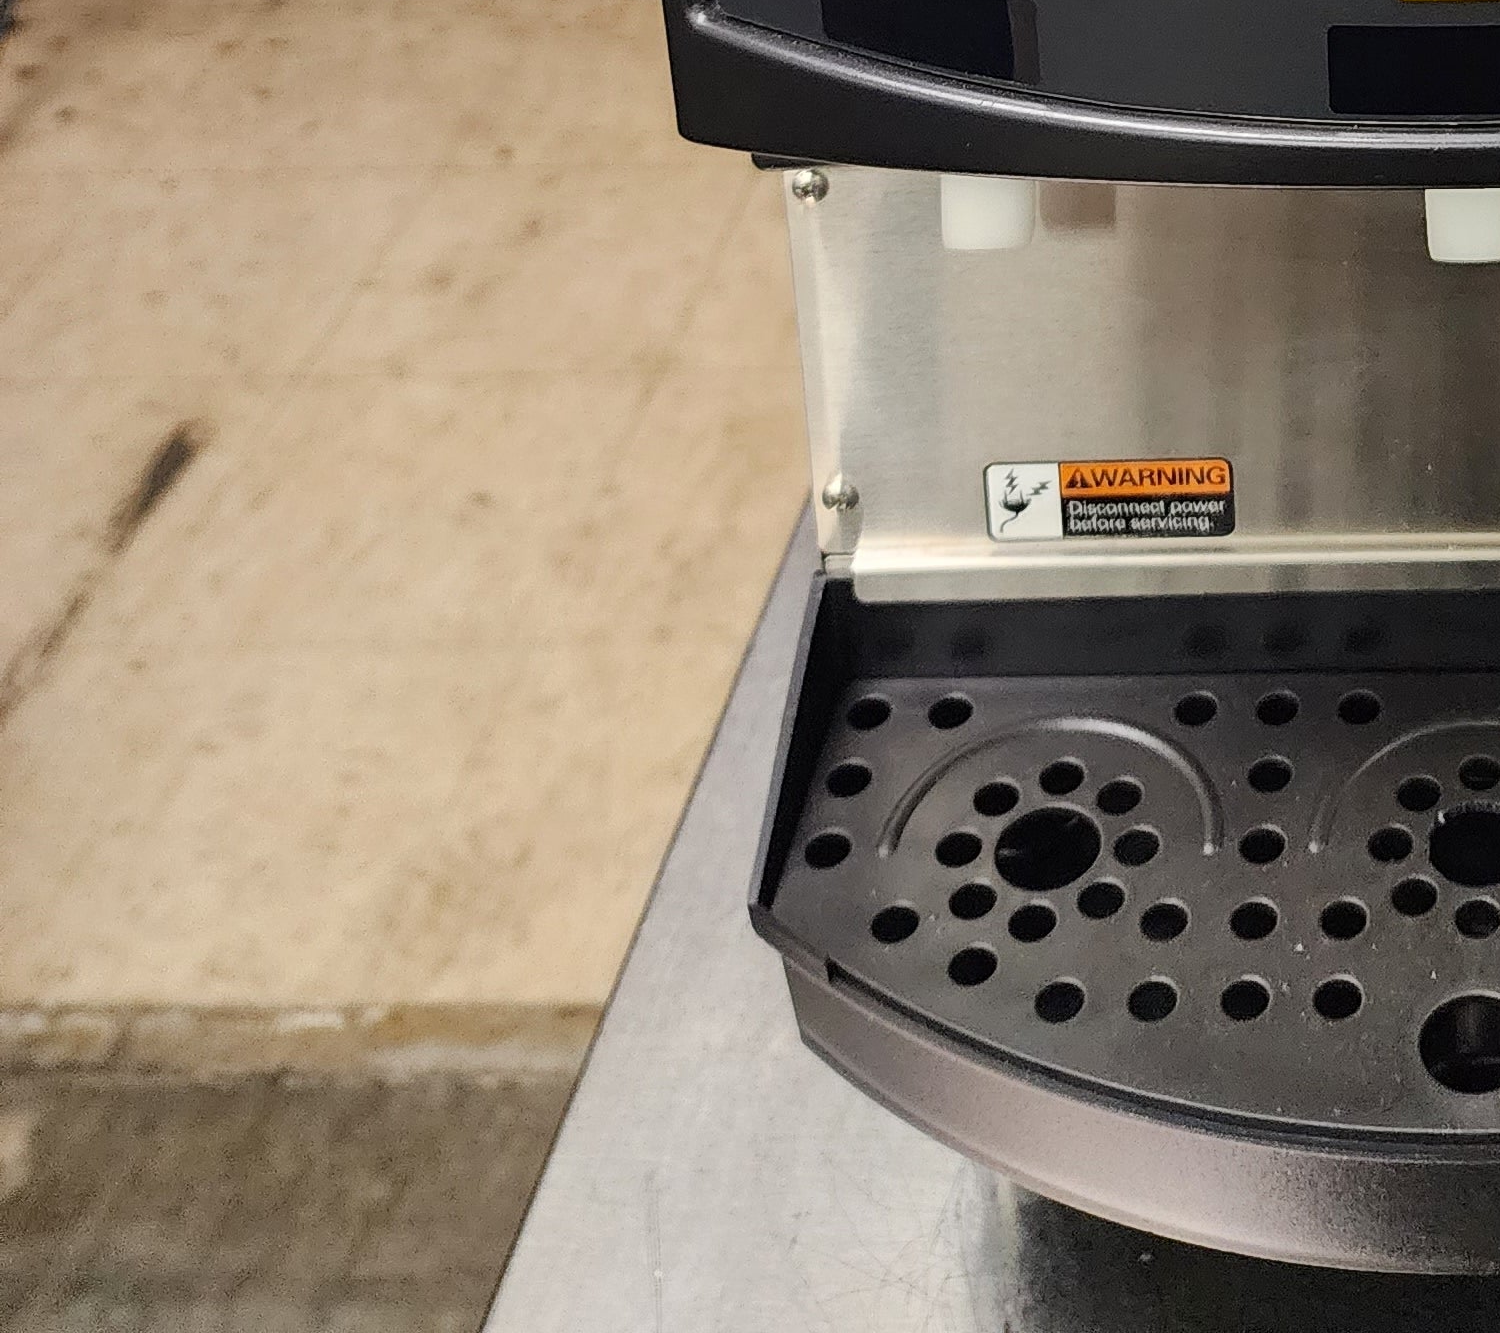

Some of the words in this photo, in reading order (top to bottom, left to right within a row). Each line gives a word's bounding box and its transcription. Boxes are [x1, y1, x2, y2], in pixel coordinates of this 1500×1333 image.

[1091, 466, 1226, 487] WARNING
[1069, 500, 1166, 517] Disconnect
[1170, 499, 1225, 518] power
[1069, 517, 1125, 533] before
[1130, 515, 1214, 532] servicing.
